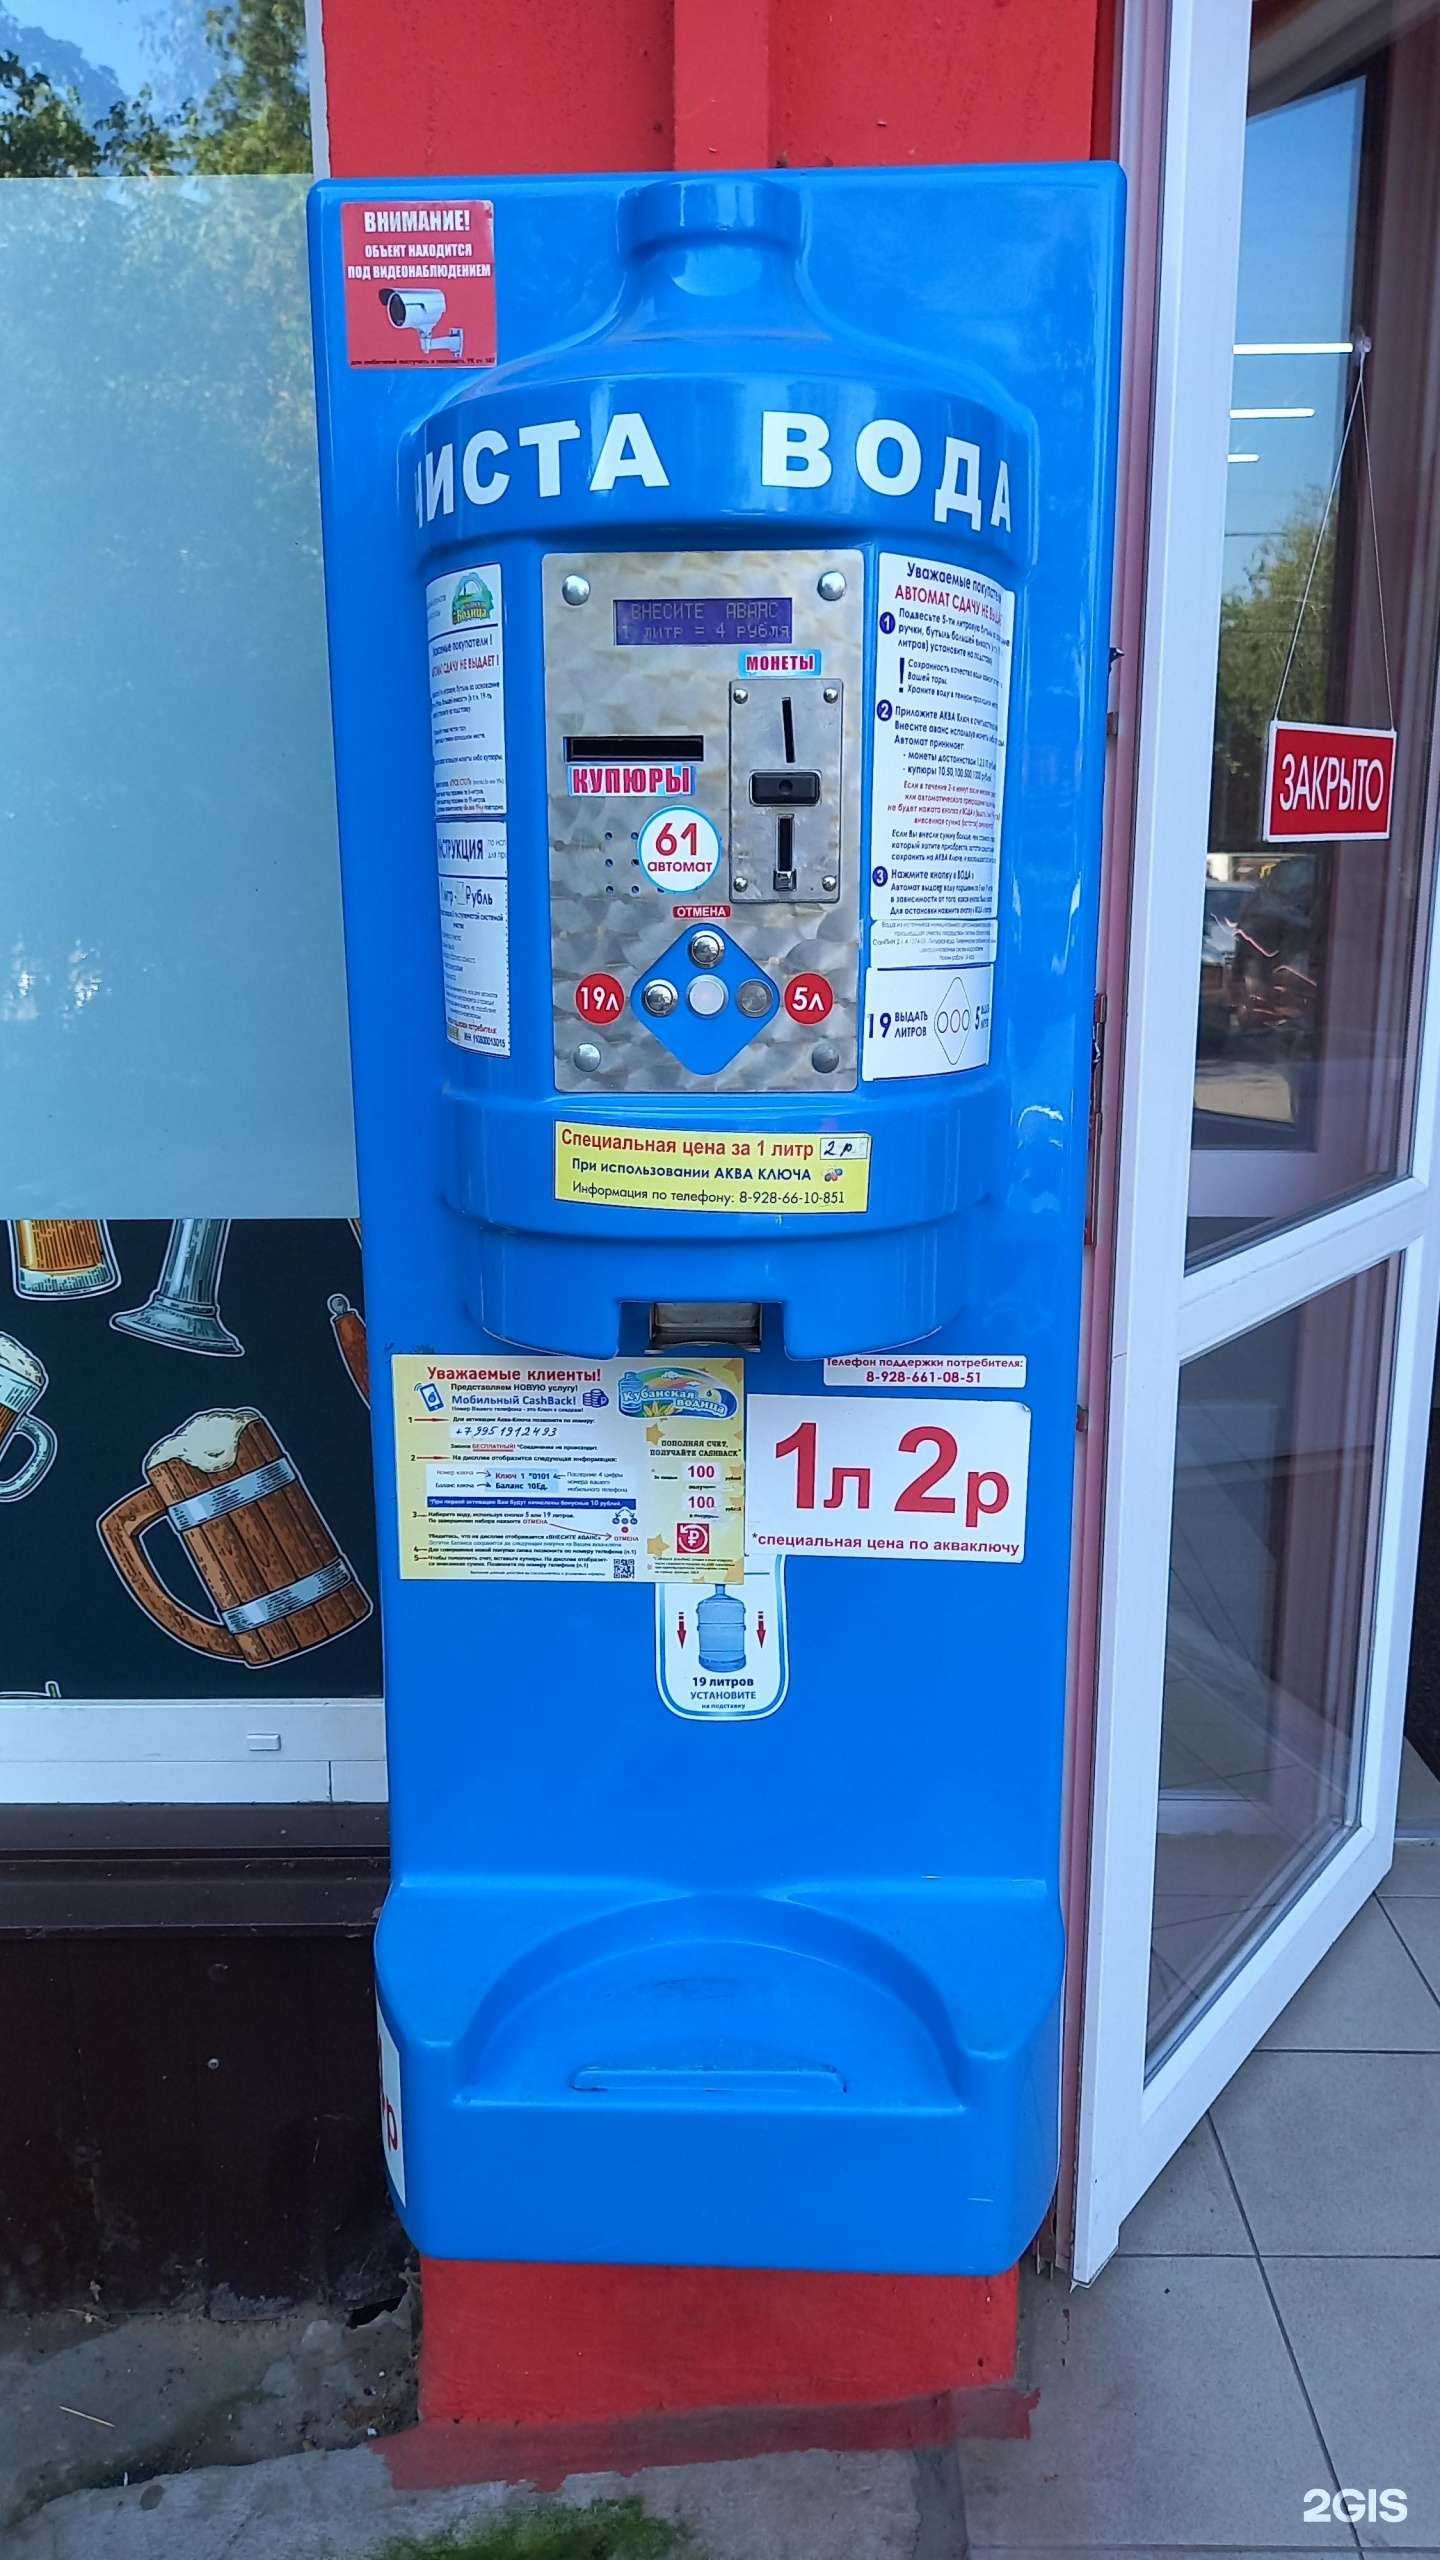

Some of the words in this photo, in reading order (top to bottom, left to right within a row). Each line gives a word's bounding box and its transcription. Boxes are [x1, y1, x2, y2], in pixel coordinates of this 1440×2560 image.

[364, 209, 470, 232] ВНИМАНИЕ!
[365, 244, 406, 258] ОБЪЕКТ
[408, 243, 472, 258] НАХОДИТСЯ
[347, 266, 371, 279] ПОД
[373, 264, 491, 279] ВИДЕОНАБЛЮДЕНИЕМ
[761, 411, 1011, 533] ВОДА
[907, 562, 970, 590] Уважаемые
[895, 585, 949, 608] АВТОМАТ
[952, 595, 980, 616] СДАЧУ
[631, 602, 705, 619] ВНЕСИТЕ
[898, 608, 940, 622] Подвесьте
[643, 627, 683, 639] литр
[715, 622, 725, 638] 4
[736, 622, 790, 639] рубля
[898, 625, 924, 637] ручки,
[926, 626, 950, 640] бутыль
[898, 639, 929, 653] литров)
[930, 643, 966, 657] установите
[746, 655, 814, 671] МОНЕТЫ
[907, 684, 936, 696] Храните
[881, 703, 889, 719] 2
[895, 705, 938, 719] Приложите
[894, 721, 927, 733] Внесите
[894, 735, 928, 746] Автомат
[908, 752, 937, 761] монеты
[907, 766, 937, 776] купюры
[573, 767, 690, 794] КУПЮРЫ
[1279, 753, 1384, 812] ЗАКРЫТО
[655, 822, 698, 856] 61
[892, 829, 908, 838] Если
[909, 830, 918, 838] Вы
[891, 841, 921, 850] который
[647, 861, 713, 873] автомат
[891, 868, 929, 879] Нажмите
[890, 883, 920, 892] Автомат
[676, 907, 727, 917] ОТМЕНА
[890, 907, 903, 916] Для
[580, 986, 620, 1011] 19л
[791, 987, 824, 1011] 5л
[868, 1012, 892, 1038] 19
[894, 1010, 929, 1023] ВЫДАТЬ
[894, 1026, 927, 1038] ЛИТРОВ
[561, 1128, 677, 1153] Специальная
[682, 1139, 726, 1158] цена
[731, 1143, 751, 1156] за
[757, 1139, 765, 1157] 1
[772, 1142, 814, 1160] литр
[572, 1158, 597, 1173] При
[601, 1161, 710, 1179] использовании
[714, 1166, 753, 1179] АКВА
[758, 1167, 811, 1181] КЛЮЧА
[572, 1181, 648, 1199] Информация
[652, 1189, 667, 1202] по
[671, 1188, 734, 1205] телефону:
[739, 1191, 845, 1204] 8-928-66-10-851
[827, 1358, 878, 1369] Телефон
[879, 1358, 944, 1369] поддержки
[946, 1358, 1023, 1369] потребителя:
[427, 1366, 521, 1380] Уважаемые
[528, 1367, 601, 1382] клиенты!
[866, 1371, 982, 1384] 8-928-661-08-51
[451, 1383, 512, 1391] Представляем
[548, 1384, 578, 1393] услугу!
[623, 1388, 696, 1401] Кубанская
[452, 1395, 520, 1405] Мобильный
[522, 1395, 577, 1405] CashBack!
[676, 1400, 726, 1414] водица
[687, 1465, 715, 1478] 100
[775, 1422, 871, 1509] 1л
[894, 1425, 1010, 1528] 2р
[688, 1496, 715, 1509] 100
[867, 1538, 905, 1551] цена
[909, 1540, 929, 1553] по
[933, 1540, 1020, 1556] акваключу
[692, 1677, 707, 1687] 19
[709, 1677, 754, 1689] литров
[690, 1691, 757, 1700] УСТАНОВИТЕ
